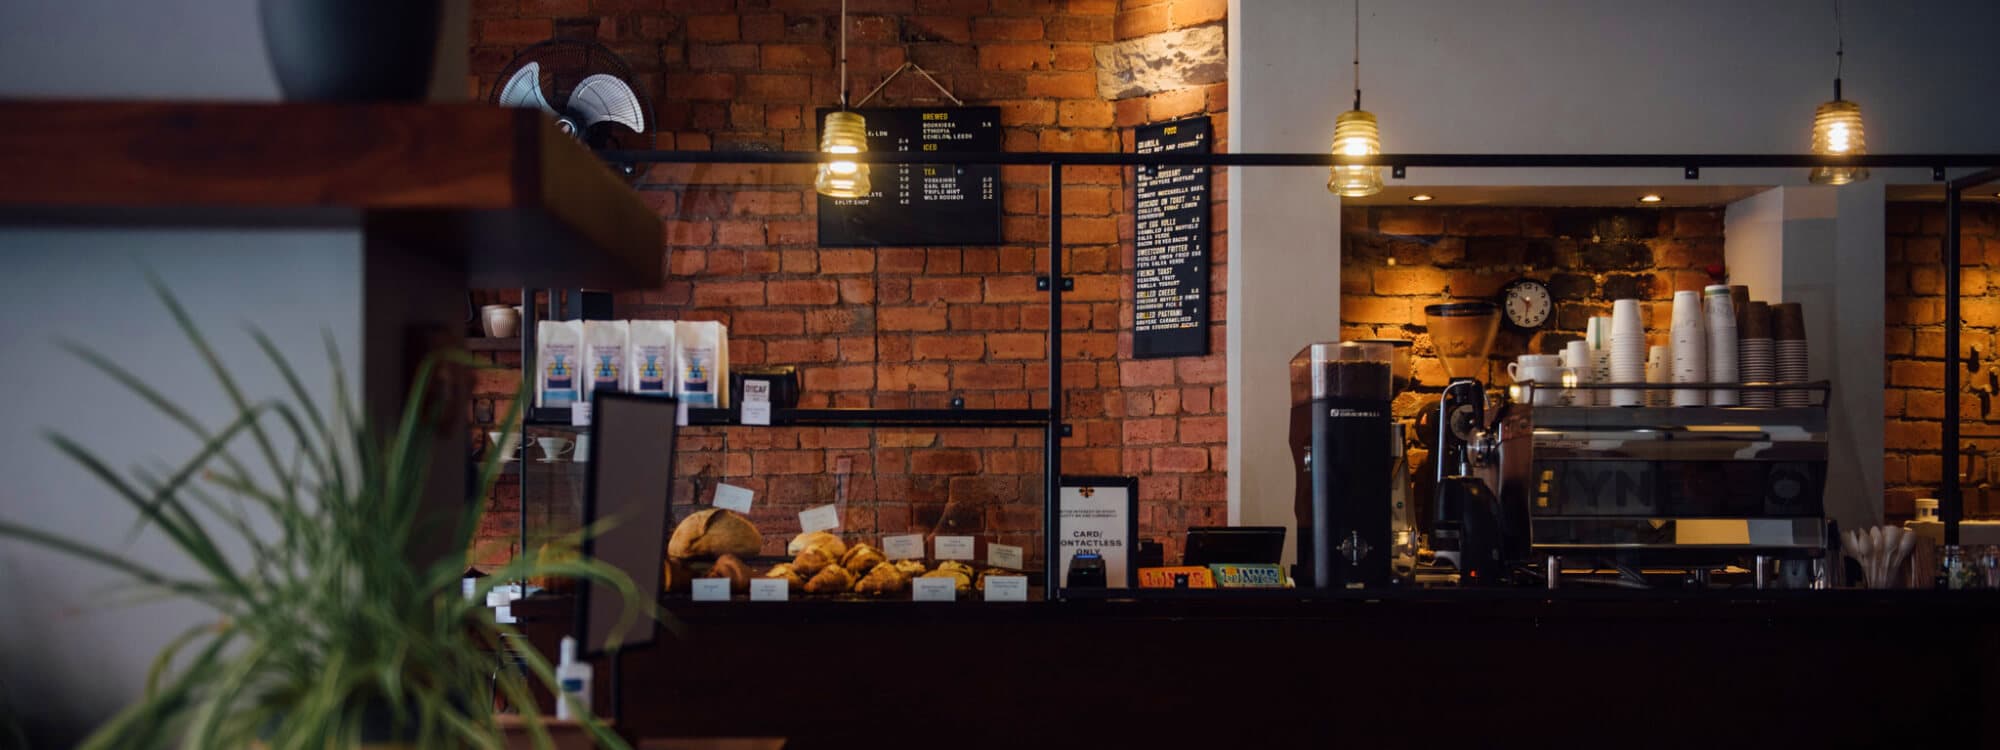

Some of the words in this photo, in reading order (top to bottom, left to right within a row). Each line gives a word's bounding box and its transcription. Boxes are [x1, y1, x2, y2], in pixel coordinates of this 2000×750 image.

[923, 113, 948, 121] BREWED
[1164, 126, 1177, 135] FOOD
[1138, 139, 1159, 148] GRANOLA
[924, 168, 936, 176] TEA
[1138, 199, 1158, 208] AVOCADO
[1170, 196, 1184, 204] TOAST
[1161, 218, 1175, 226] ROLLS
[1137, 248, 1165, 256] SWEETCORN
[1168, 244, 1188, 253] FRITTER
[1137, 269, 1155, 277] FRENCH
[1157, 267, 1172, 275] TOAST
